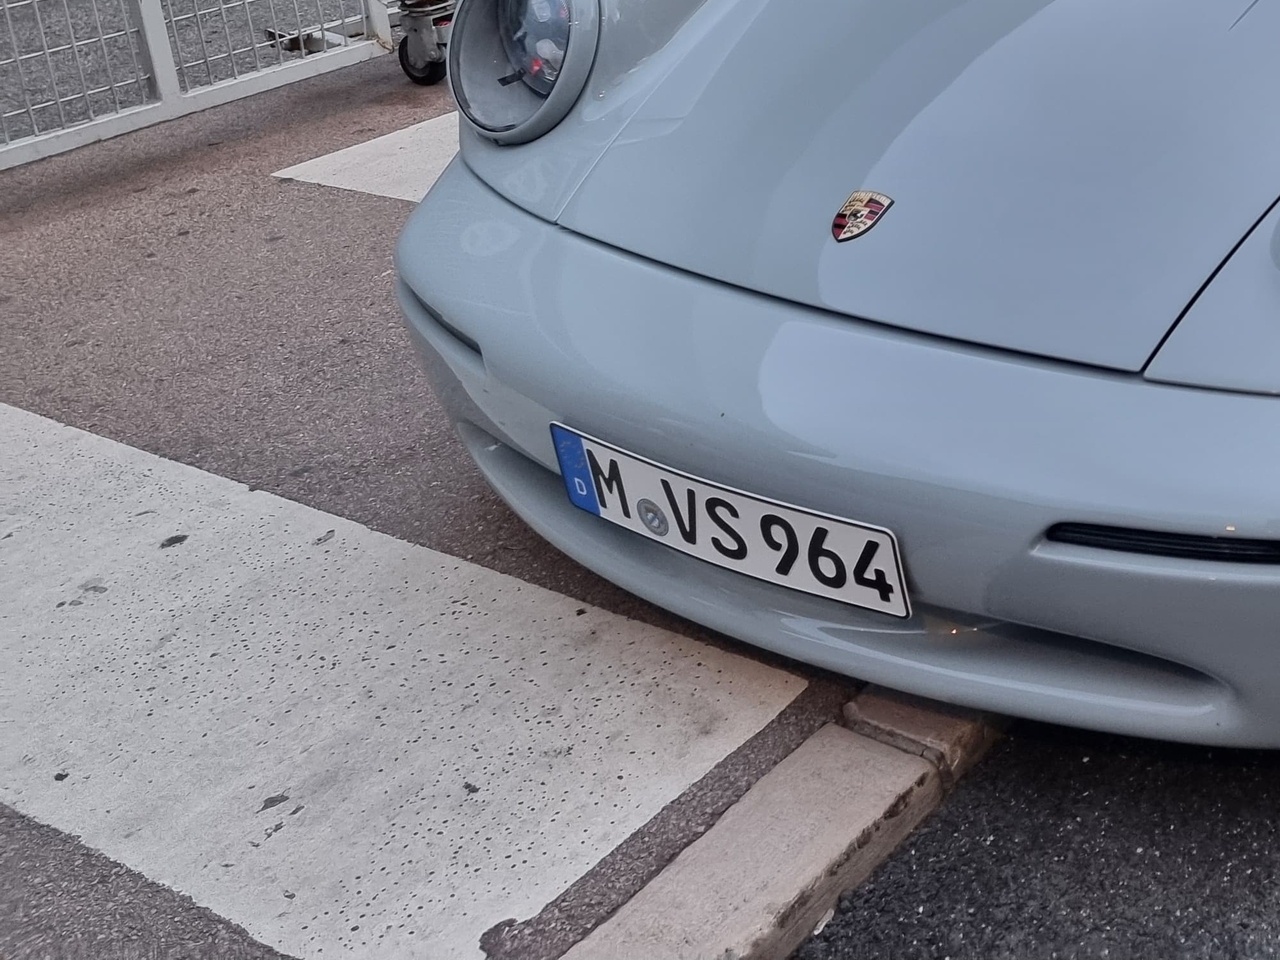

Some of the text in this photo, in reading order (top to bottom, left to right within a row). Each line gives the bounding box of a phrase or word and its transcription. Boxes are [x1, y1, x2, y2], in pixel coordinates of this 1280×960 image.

[575, 478, 587, 495] D
[586, 448, 631, 519] M
[760, 514, 894, 602] 964
